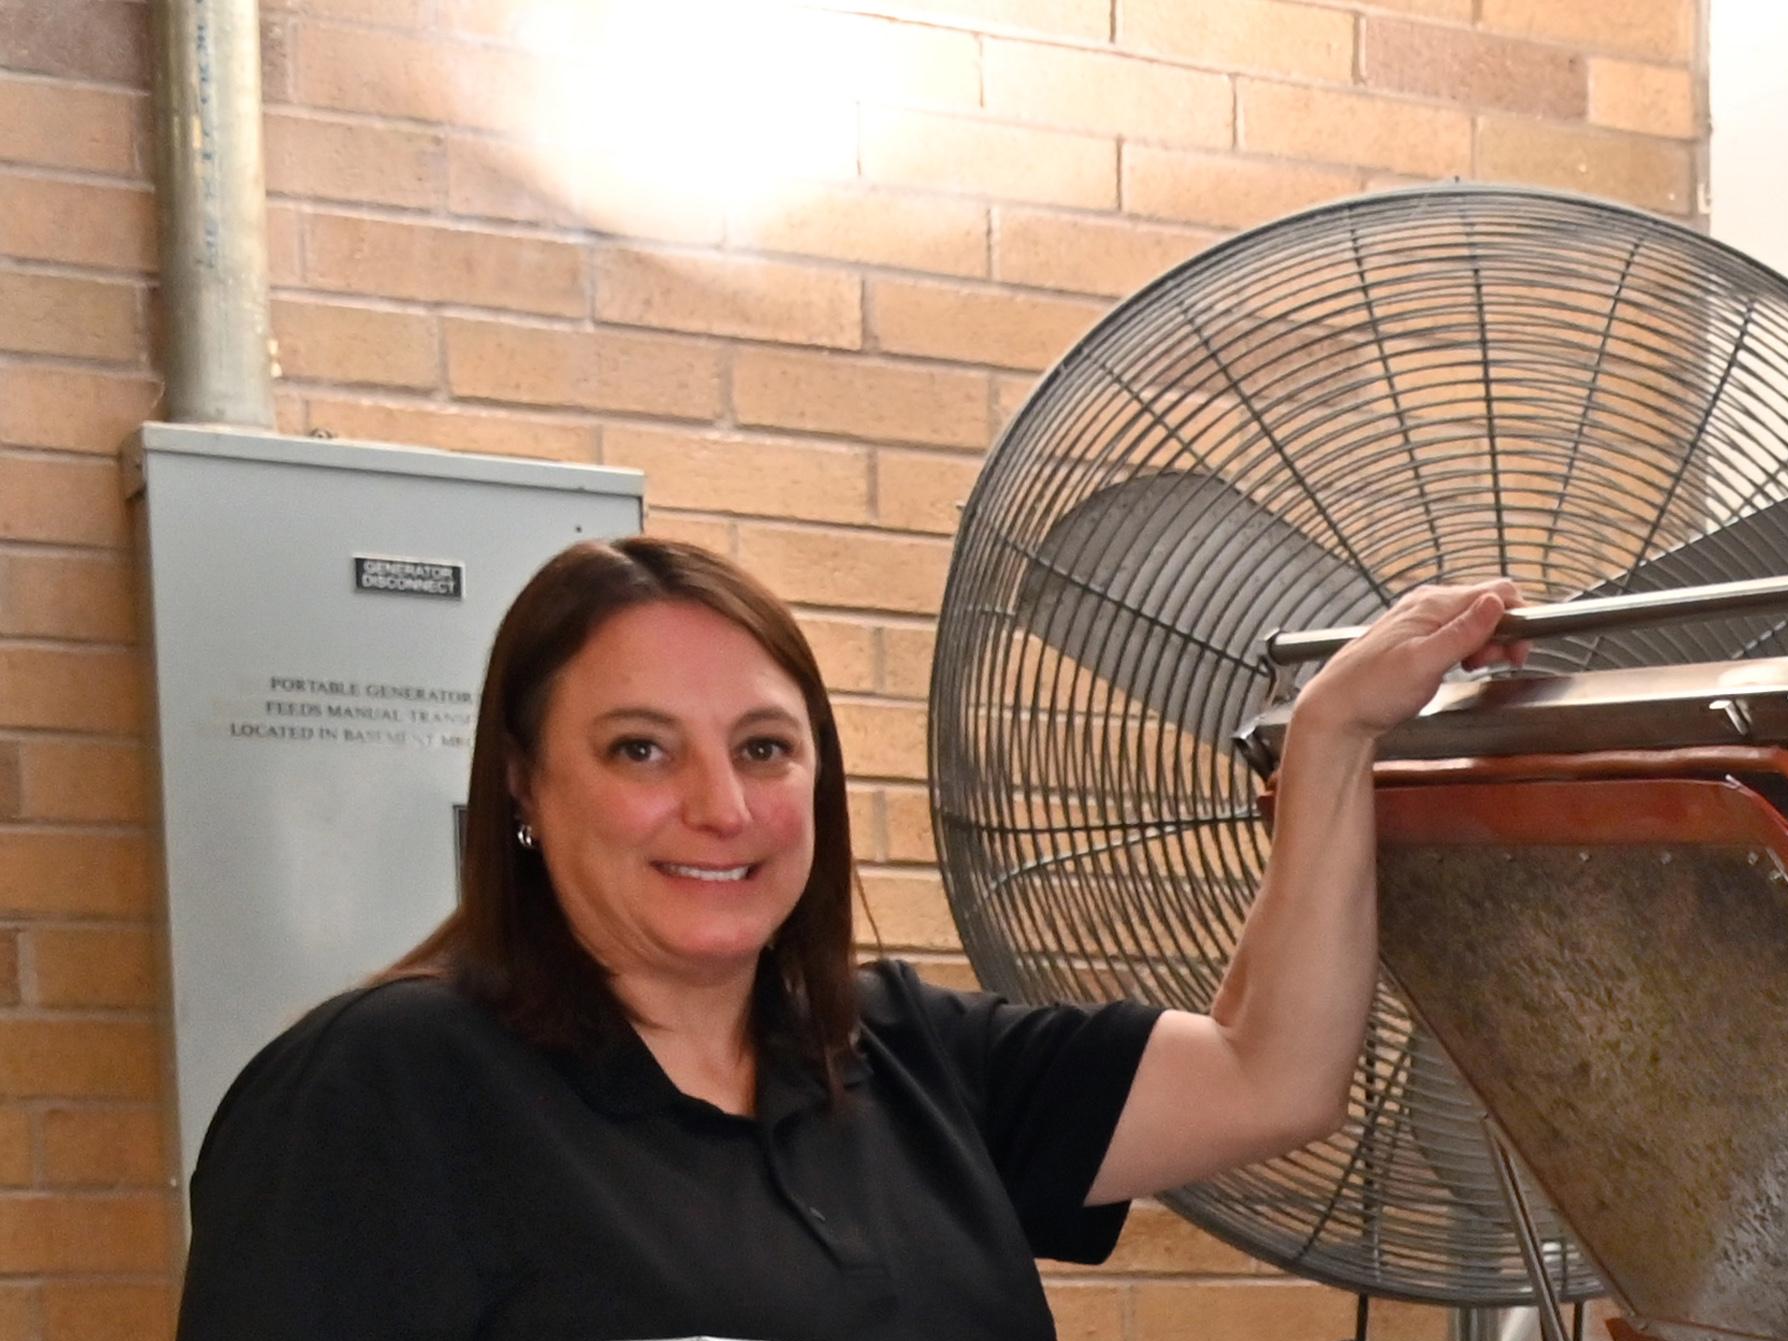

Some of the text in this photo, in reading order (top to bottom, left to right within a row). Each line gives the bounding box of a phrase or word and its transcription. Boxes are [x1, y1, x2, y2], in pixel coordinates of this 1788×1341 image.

[363, 560, 453, 579] GENERATOR
[361, 574, 455, 594] DISCONNECT
[271, 676, 472, 702] PORTABLE GENERATOR
[266, 701, 322, 717] FEEDS
[327, 705, 399, 721] MANUAL
[231, 723, 314, 740] LOCATED
[319, 728, 337, 740] IN
